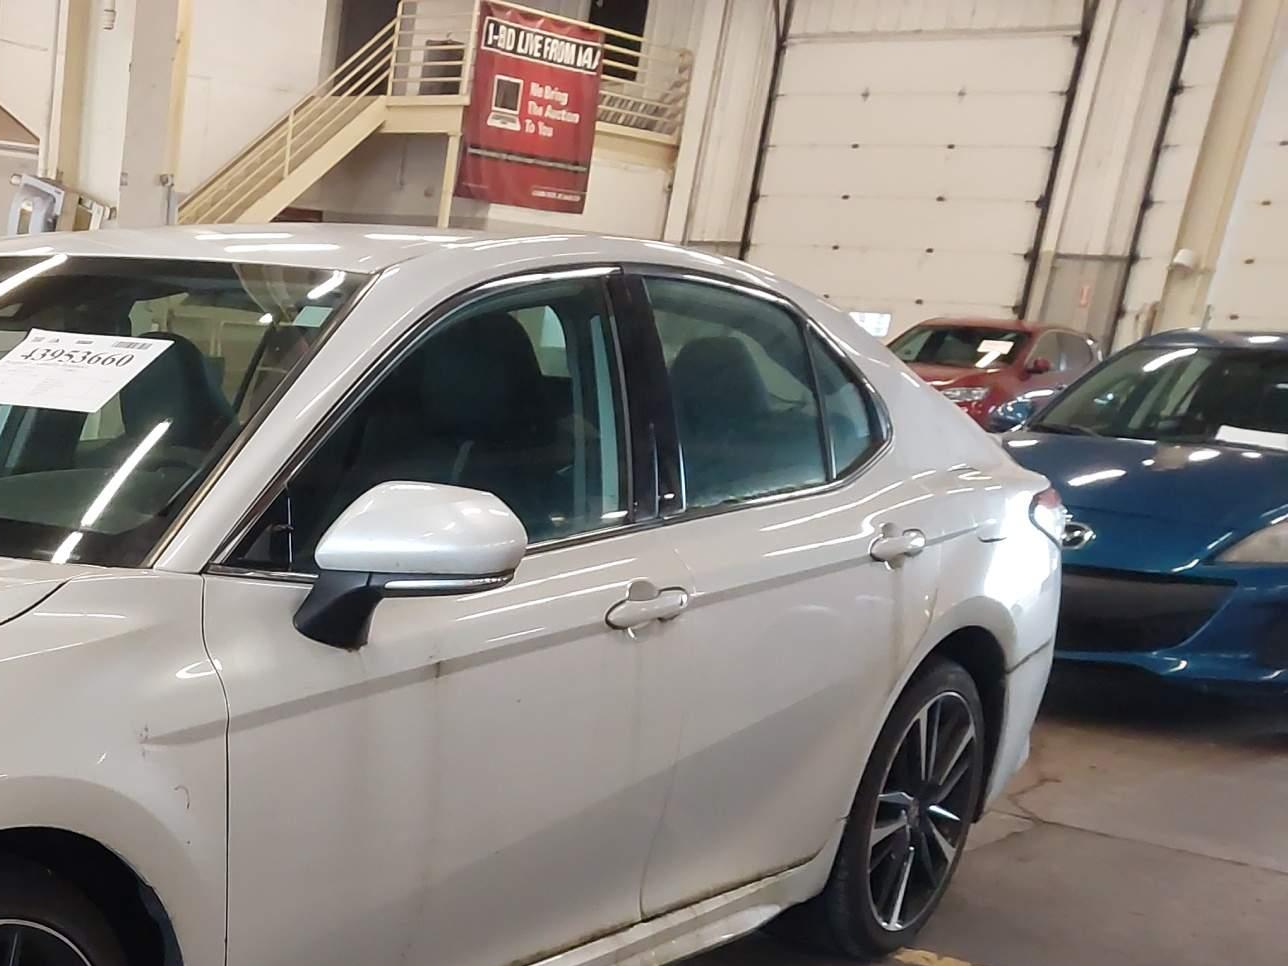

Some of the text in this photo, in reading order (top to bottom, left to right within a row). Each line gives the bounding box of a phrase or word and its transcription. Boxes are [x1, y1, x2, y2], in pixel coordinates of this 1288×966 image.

[516, 30, 543, 58] LIVE
[543, 37, 577, 66] FROM
[544, 86, 569, 106] Bring
[525, 119, 554, 137] To You
[20, 348, 135, 368] 43953660
